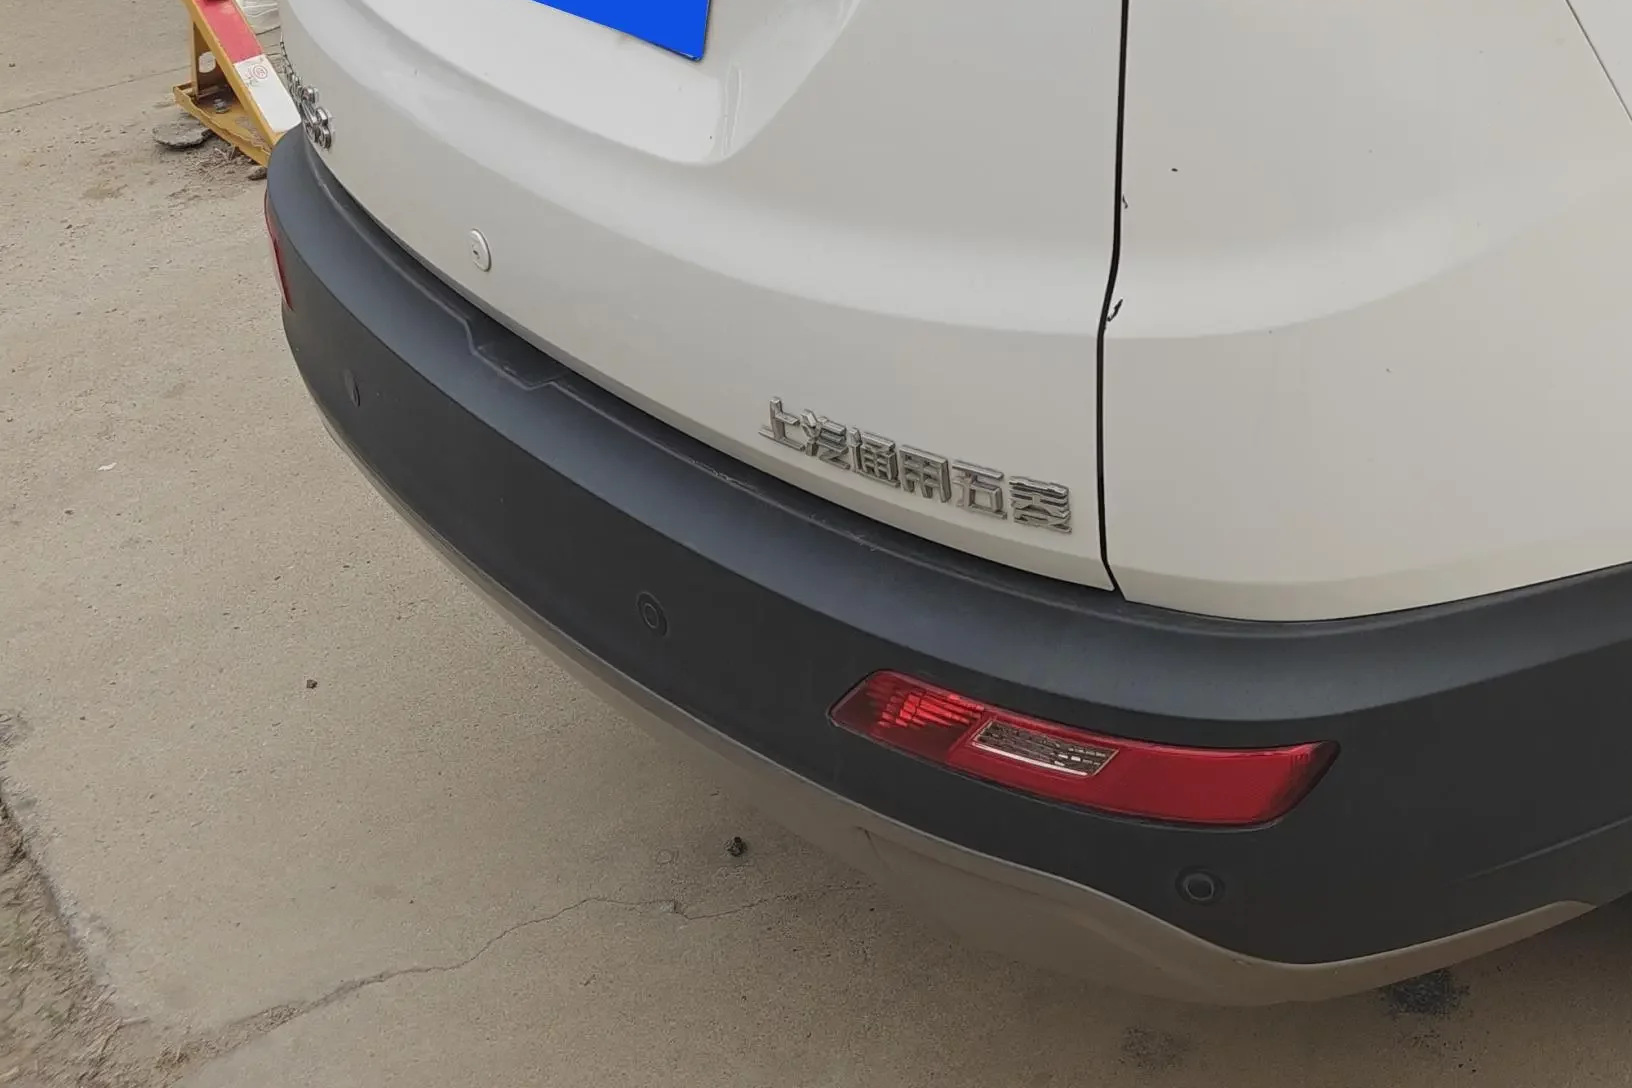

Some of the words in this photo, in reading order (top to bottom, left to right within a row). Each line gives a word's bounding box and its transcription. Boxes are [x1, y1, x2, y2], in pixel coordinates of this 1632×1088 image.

[757, 395, 1073, 534] 上汽通用五菱
